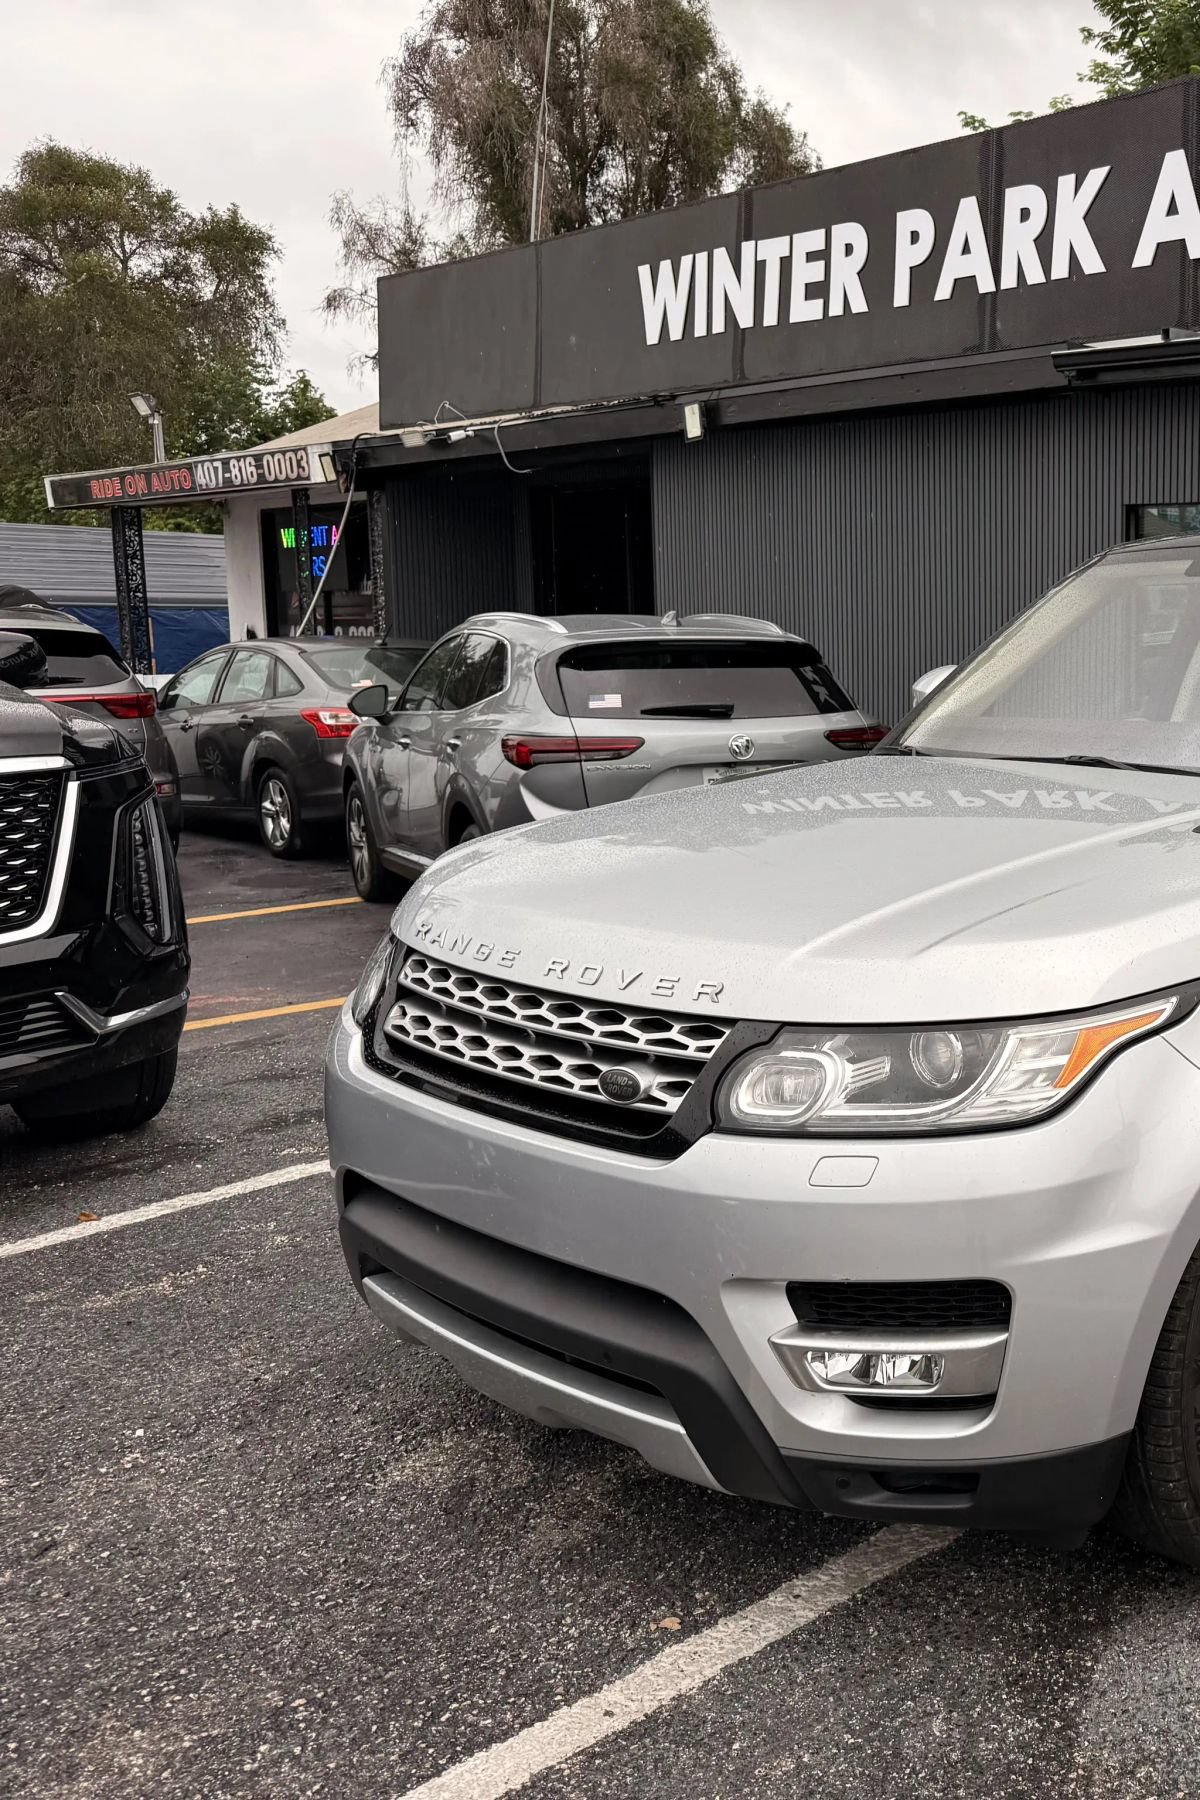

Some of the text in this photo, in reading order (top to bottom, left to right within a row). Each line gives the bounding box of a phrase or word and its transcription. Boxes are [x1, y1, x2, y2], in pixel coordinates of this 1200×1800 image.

[637, 222, 869, 346] WINTER
[893, 165, 1111, 308] PARK
[90, 468, 192, 499] RIDE ON AUTO
[196, 449, 309, 489] 407-816-0003
[415, 921, 724, 1003] RANGE ROVER
